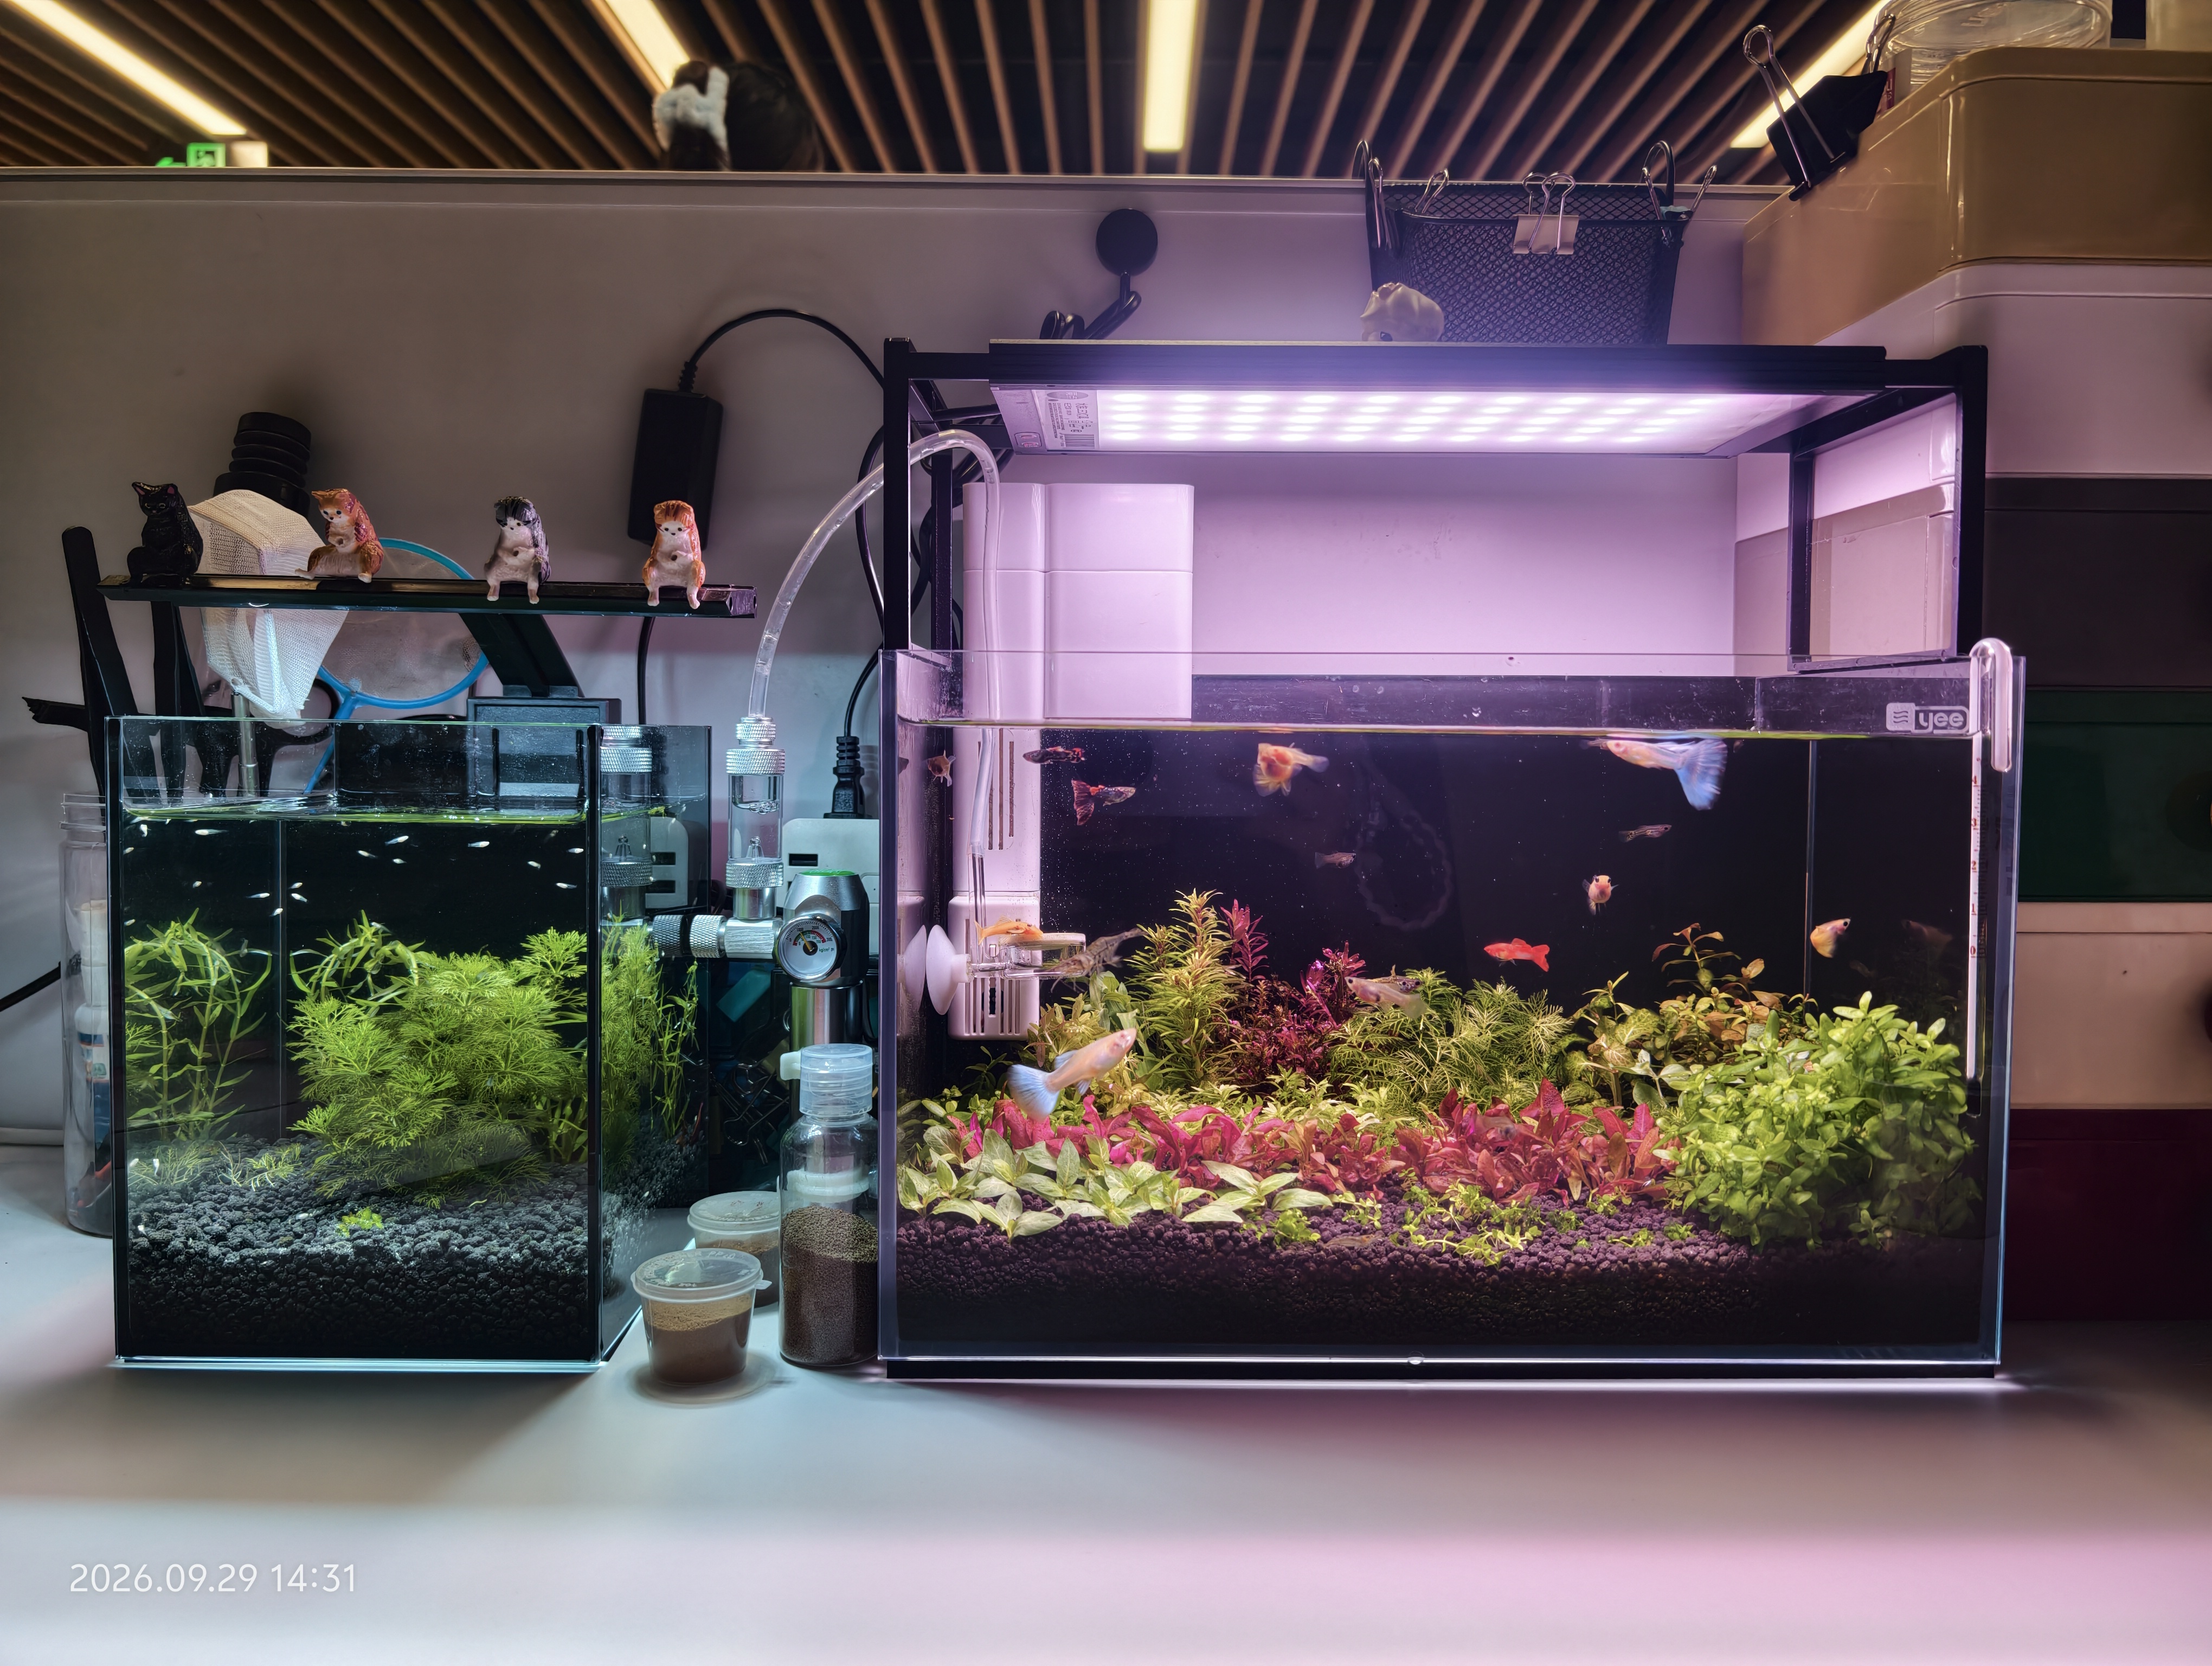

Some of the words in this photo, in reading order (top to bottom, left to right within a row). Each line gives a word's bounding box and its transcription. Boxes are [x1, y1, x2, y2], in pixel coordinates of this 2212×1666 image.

[1919, 712, 1964, 733] yee
[1971, 861, 1977, 870] 2
[1971, 904, 1976, 913] 1
[1970, 945, 1976, 955] 0
